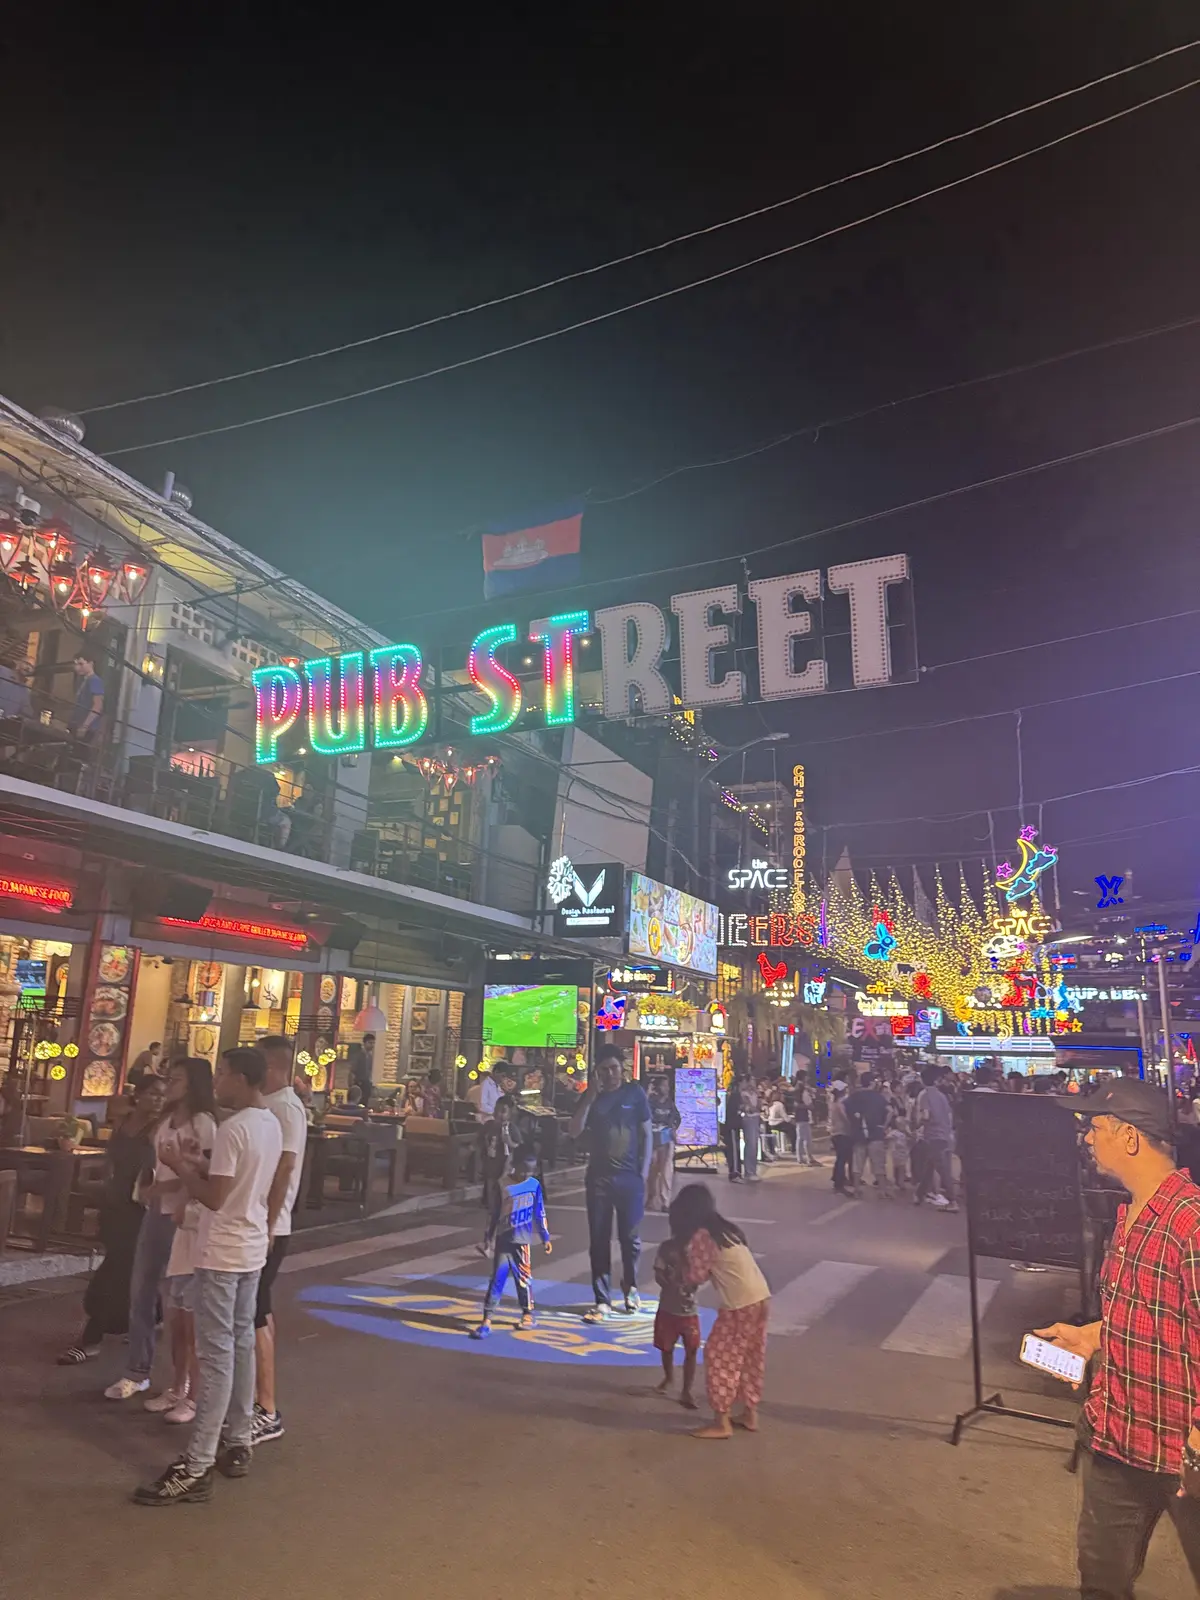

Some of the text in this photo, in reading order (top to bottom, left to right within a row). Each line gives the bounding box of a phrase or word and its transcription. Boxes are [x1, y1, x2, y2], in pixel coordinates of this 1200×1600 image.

[251, 553, 909, 764] PUB STREET
[751, 858, 768, 869] the
[728, 869, 788, 889] SPACE
[561, 907, 581, 917] Design
[993, 916, 1051, 936] SPACE
